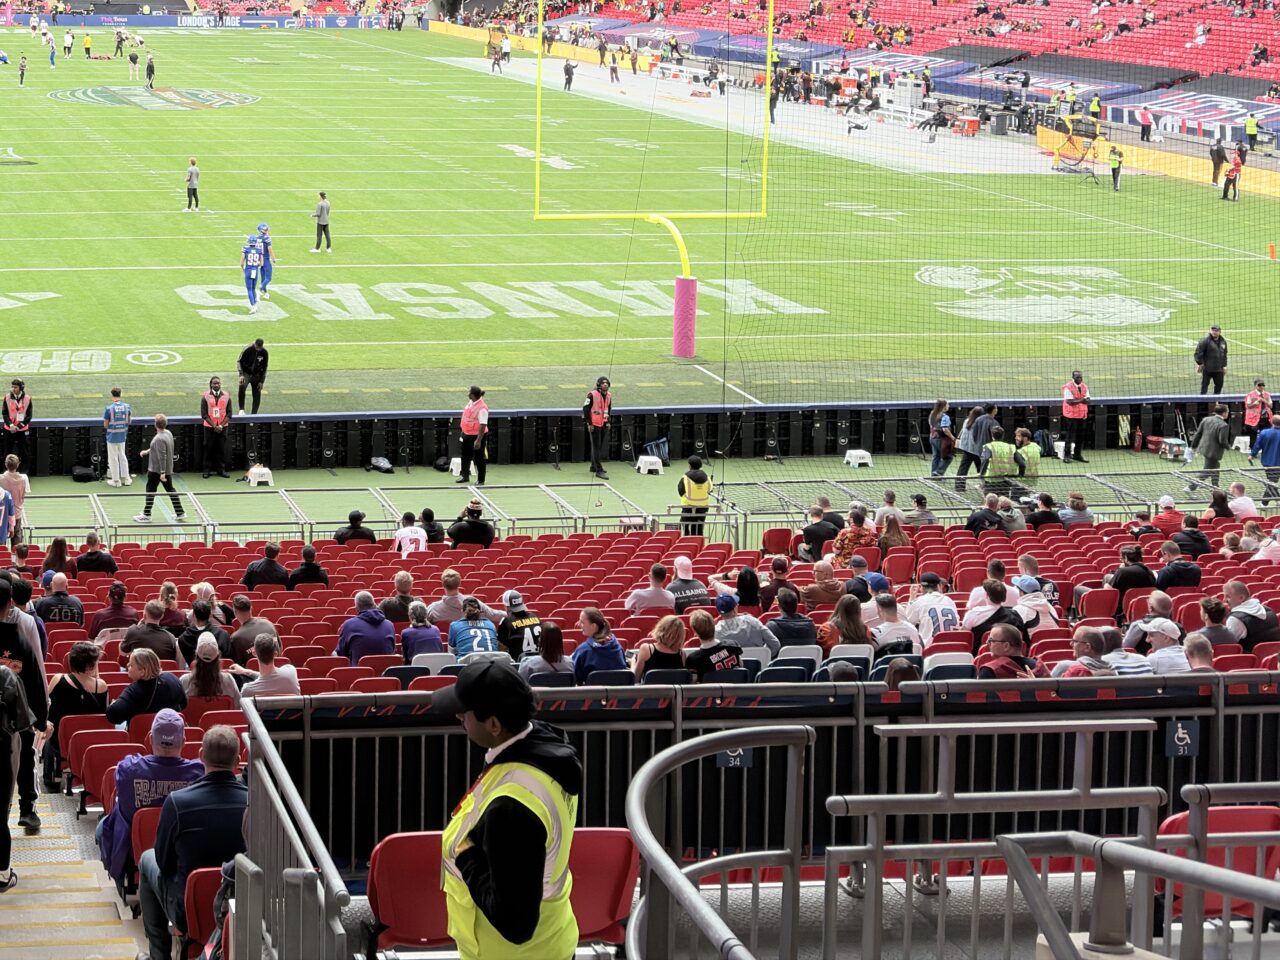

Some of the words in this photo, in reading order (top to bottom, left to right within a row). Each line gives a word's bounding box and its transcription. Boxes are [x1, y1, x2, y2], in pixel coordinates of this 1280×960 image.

[177, 16, 214, 27] LONDON'S
[247, 253, 260, 265] 99
[176, 279, 830, 322] KANSAS
[928, 607, 958, 632] 12
[470, 629, 493, 652] 21
[1178, 746, 1188, 755] 31
[729, 757, 740, 766] 34
